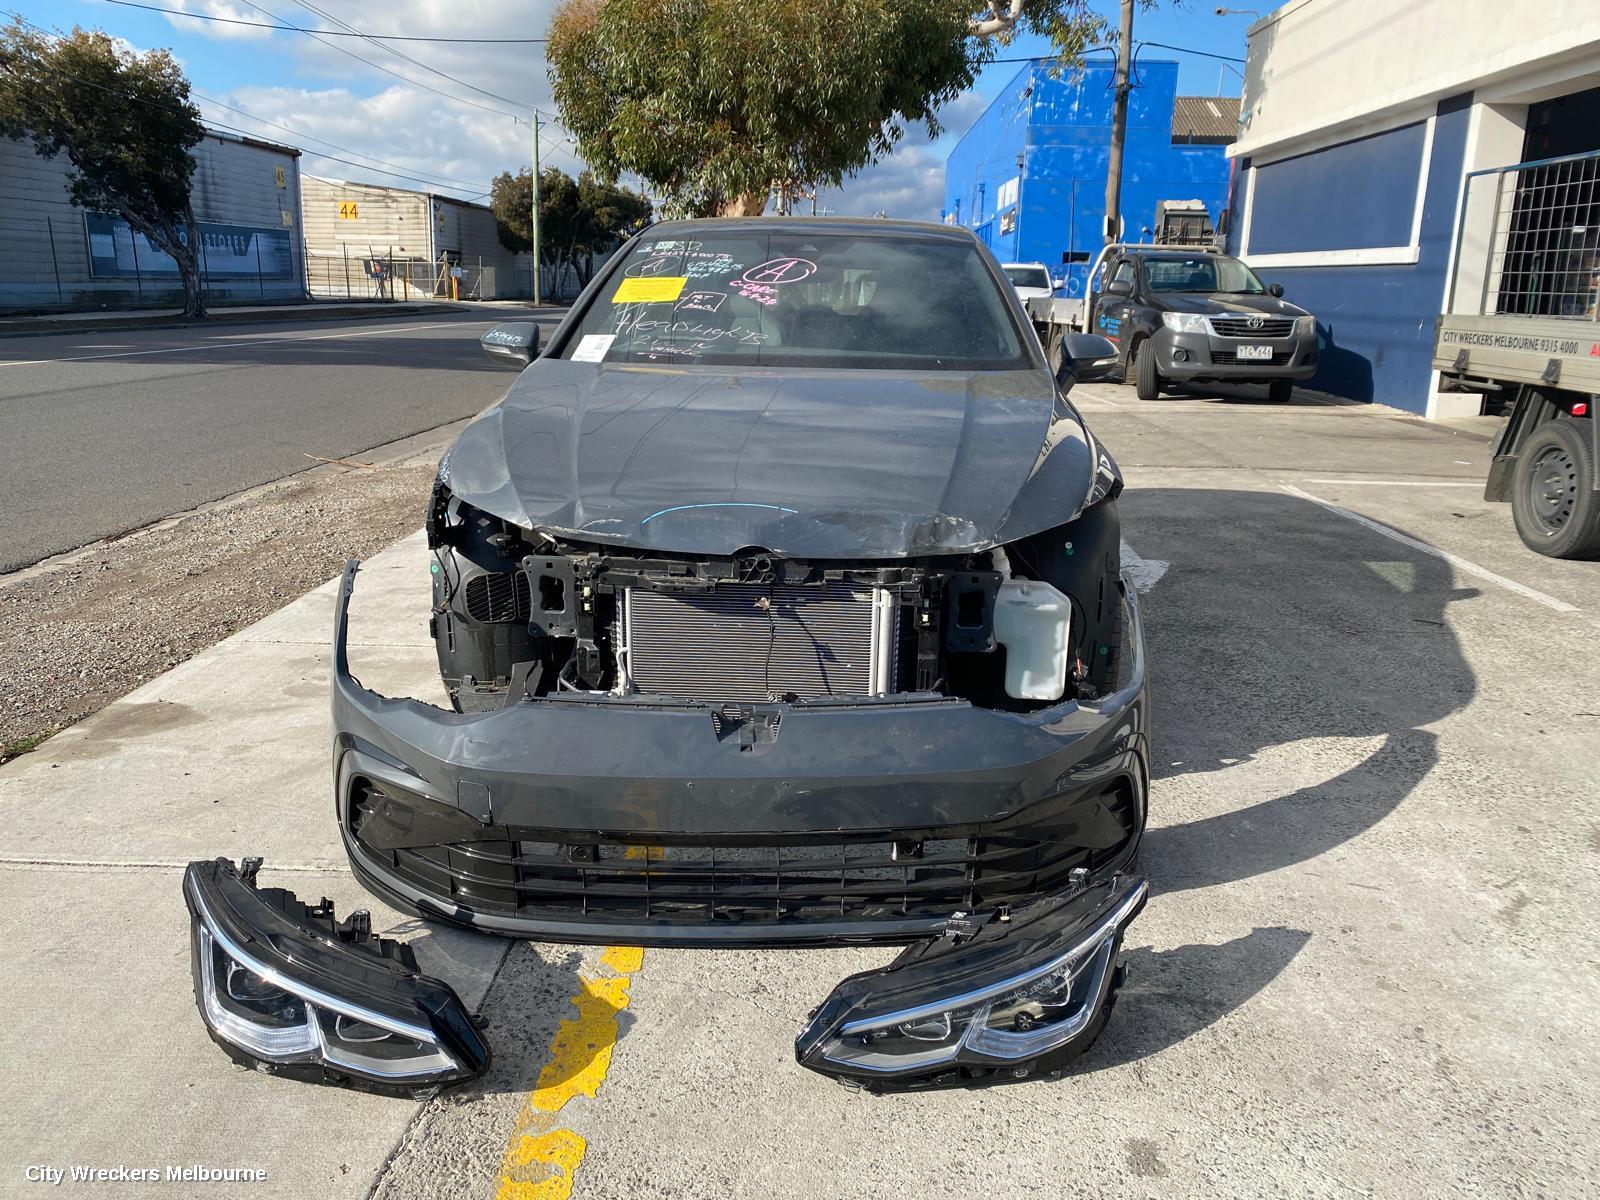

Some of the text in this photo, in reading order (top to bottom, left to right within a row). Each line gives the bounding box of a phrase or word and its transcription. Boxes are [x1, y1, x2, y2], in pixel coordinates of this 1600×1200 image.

[340, 203, 359, 220] 44
[754, 260, 799, 282] A
[1443, 331, 1579, 354] CITY WRECKERS MELBOURNE 9315 4000
